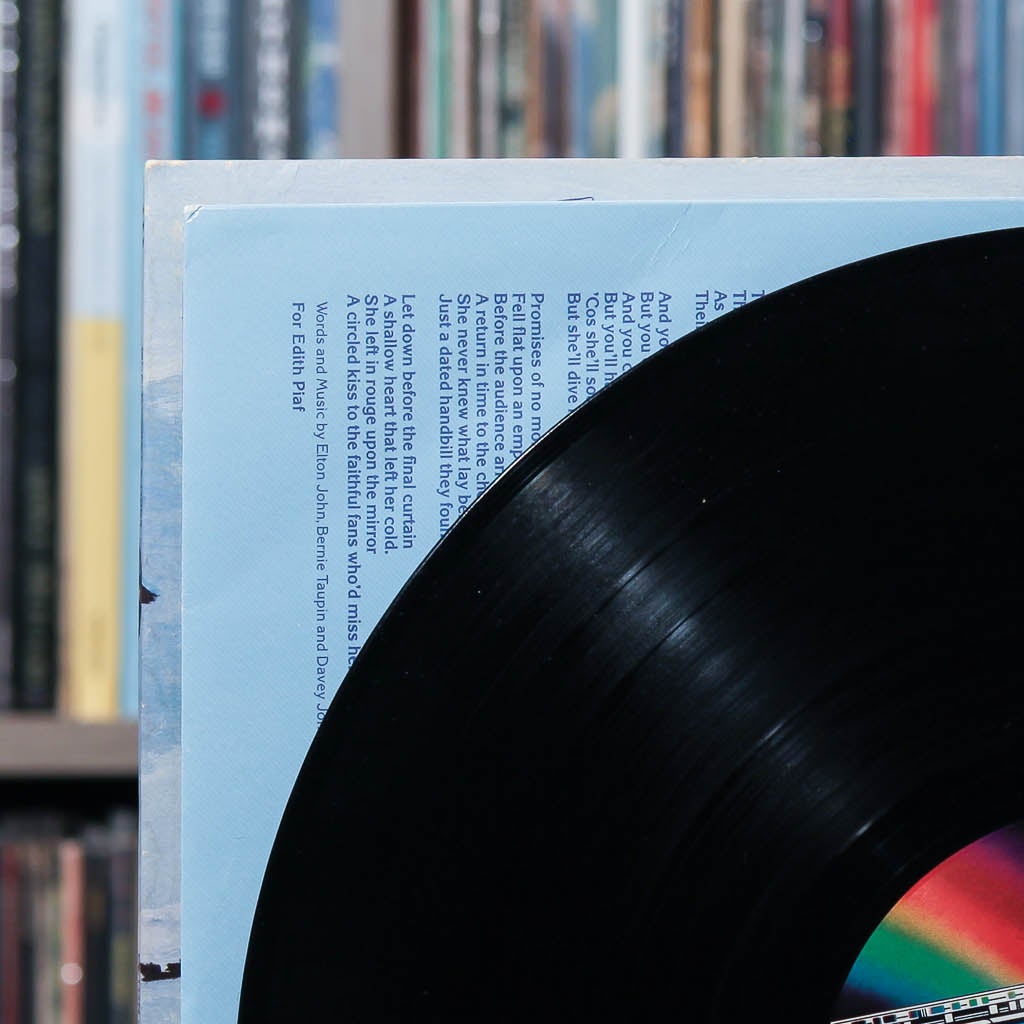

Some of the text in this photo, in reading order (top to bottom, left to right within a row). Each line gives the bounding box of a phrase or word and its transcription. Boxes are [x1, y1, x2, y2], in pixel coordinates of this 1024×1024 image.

[292, 303, 305, 412] For Edith Piaf
[347, 295, 361, 641] A circled kiss to the faithful fans who'd miss
[362, 295, 379, 554] She left in rouge upon the mirror
[384, 295, 398, 555] A shallow heart that left her cold.
[402, 295, 416, 549] Let down before the final curtain
[312, 302, 328, 699] Words and Music by Elton John, Bernie Taupin and Davey
